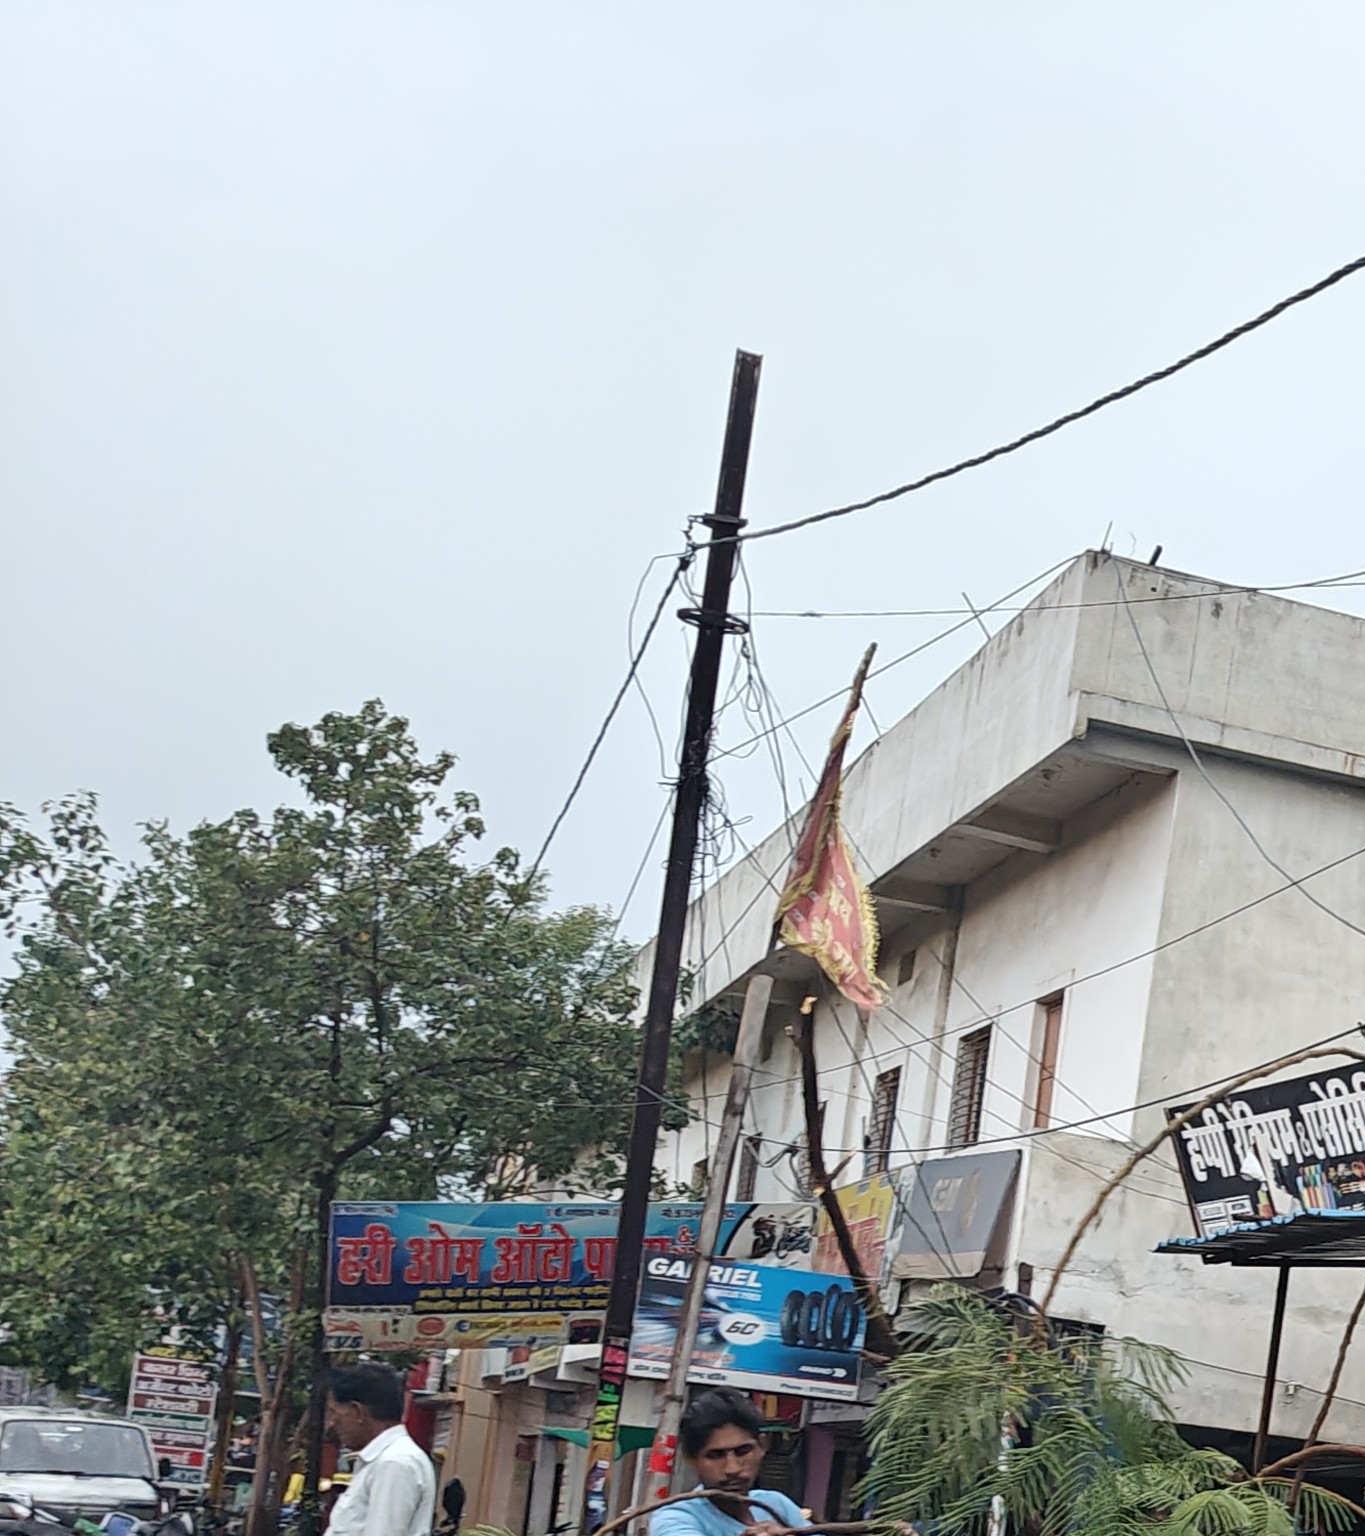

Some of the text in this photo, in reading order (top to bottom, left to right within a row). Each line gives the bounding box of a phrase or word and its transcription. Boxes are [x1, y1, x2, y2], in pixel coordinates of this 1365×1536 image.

[337, 1222, 397, 1286] हरी
[403, 1222, 486, 1285] ओम
[491, 1222, 578, 1285] ऑटो
[647, 1256, 763, 1289] GARIEL
